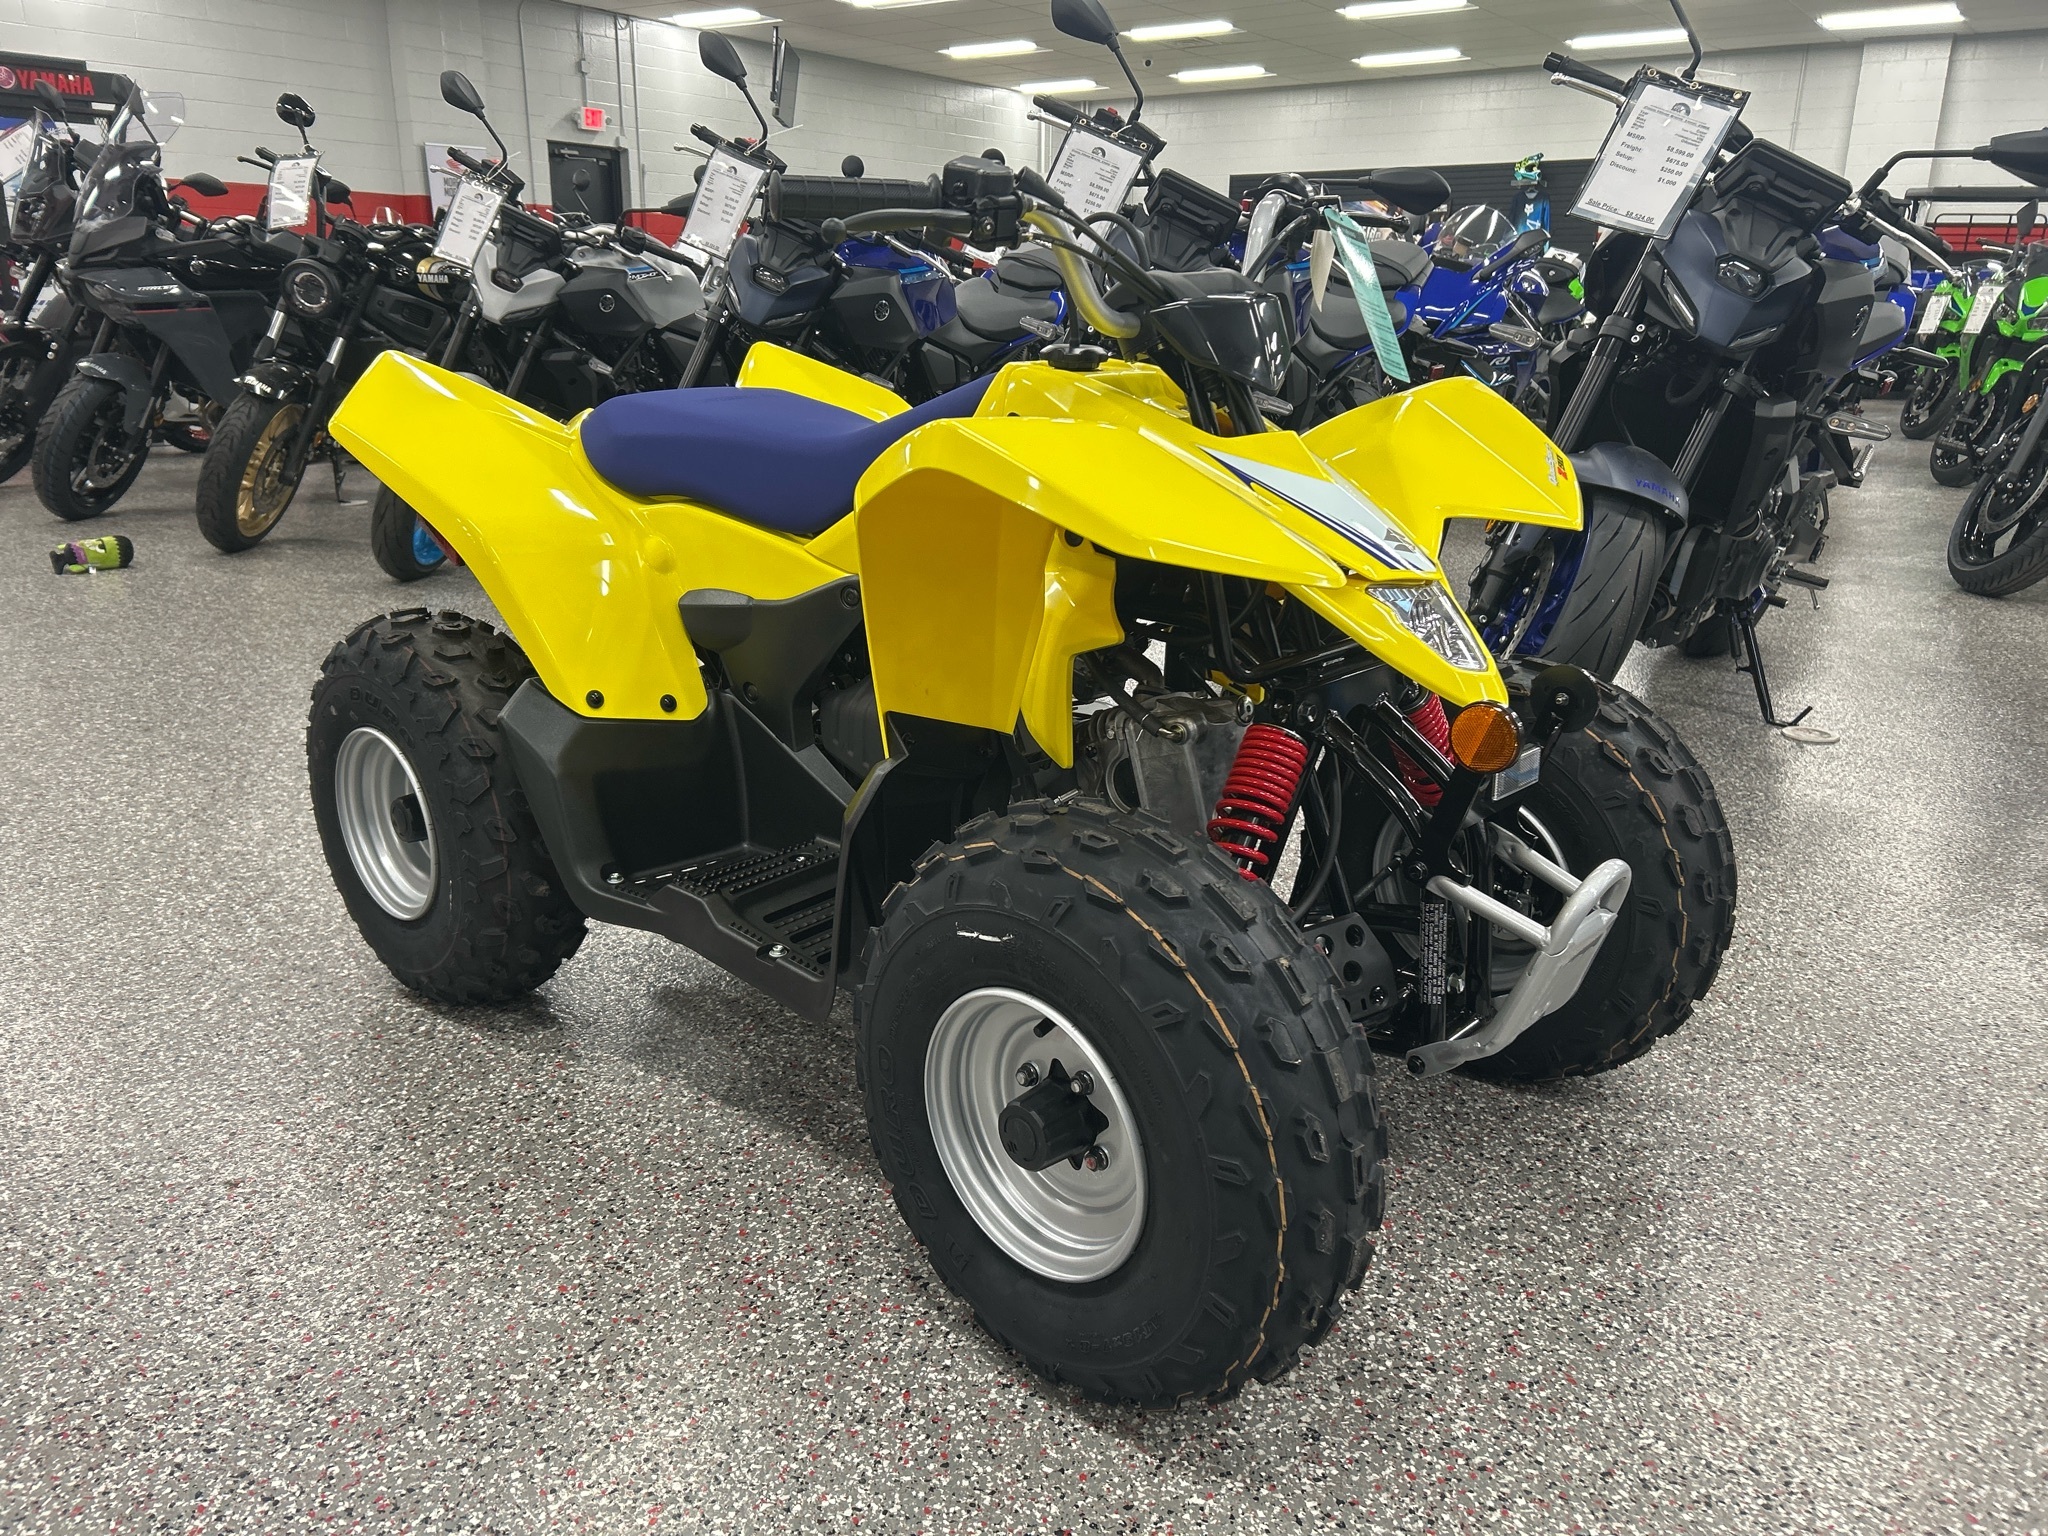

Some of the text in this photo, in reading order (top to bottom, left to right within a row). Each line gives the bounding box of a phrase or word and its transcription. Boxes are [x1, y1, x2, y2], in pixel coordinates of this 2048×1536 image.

[16, 68, 95, 97] YAMAHA
[1620, 141, 1689, 168] Freight: $675.00
[1626, 131, 1695, 159] MSRP: $8,599.00
[1609, 160, 1638, 174] Discount:
[1615, 151, 1683, 177] Setup: $250.00
[1588, 198, 1655, 224] Sale Price: $8,524.00
[417, 273, 449, 284] YAMAHA
[1635, 478, 1681, 508] YAMAHA
